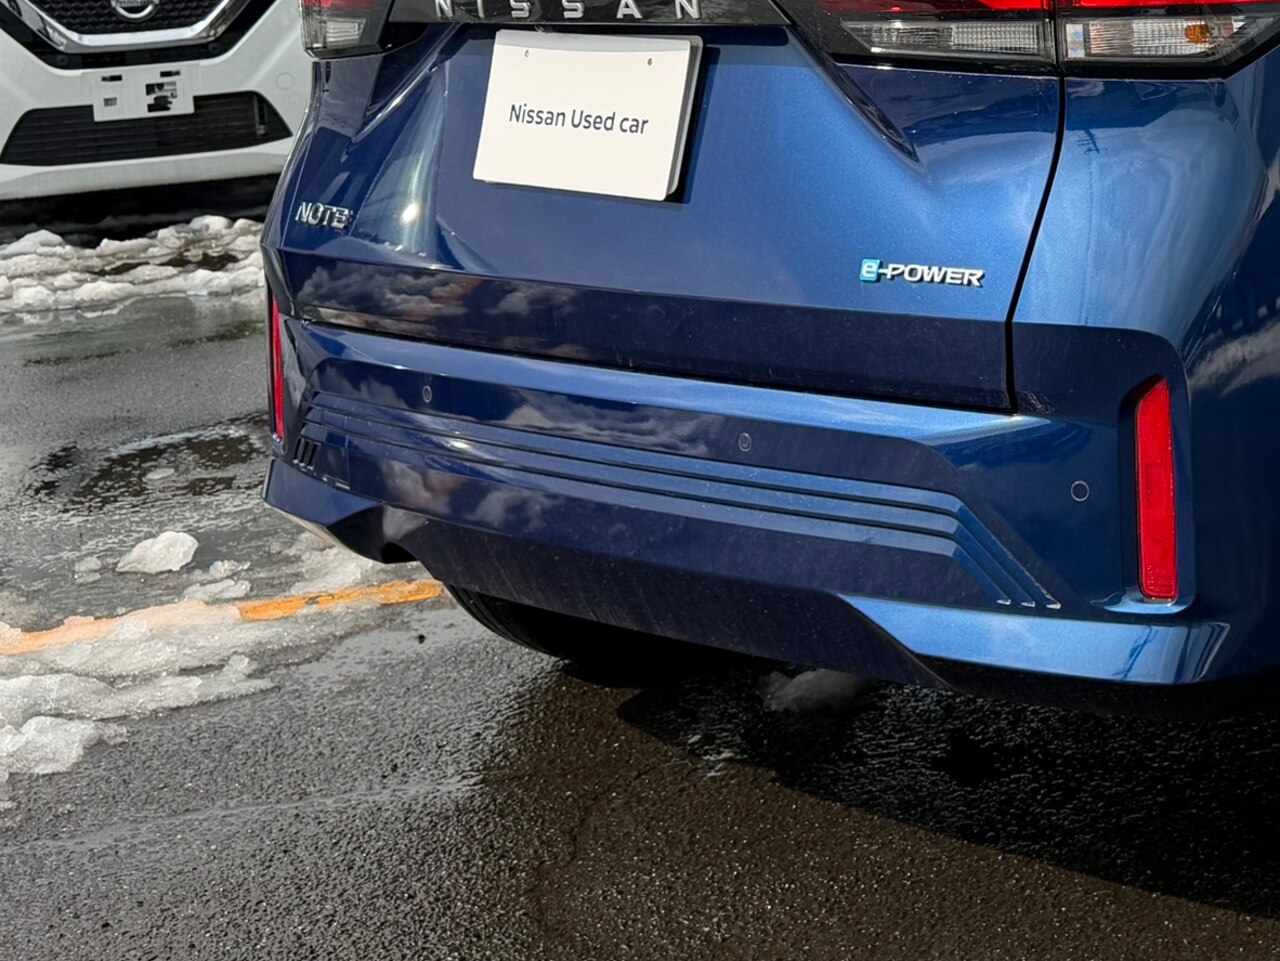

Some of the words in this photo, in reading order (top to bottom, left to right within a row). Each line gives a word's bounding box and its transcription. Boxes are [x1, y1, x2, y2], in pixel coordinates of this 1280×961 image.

[509, 103, 566, 128] Nissan
[571, 110, 616, 132] Used
[619, 115, 649, 135] car
[295, 202, 350, 229] NOTE
[860, 259, 984, 287] e-POWER
